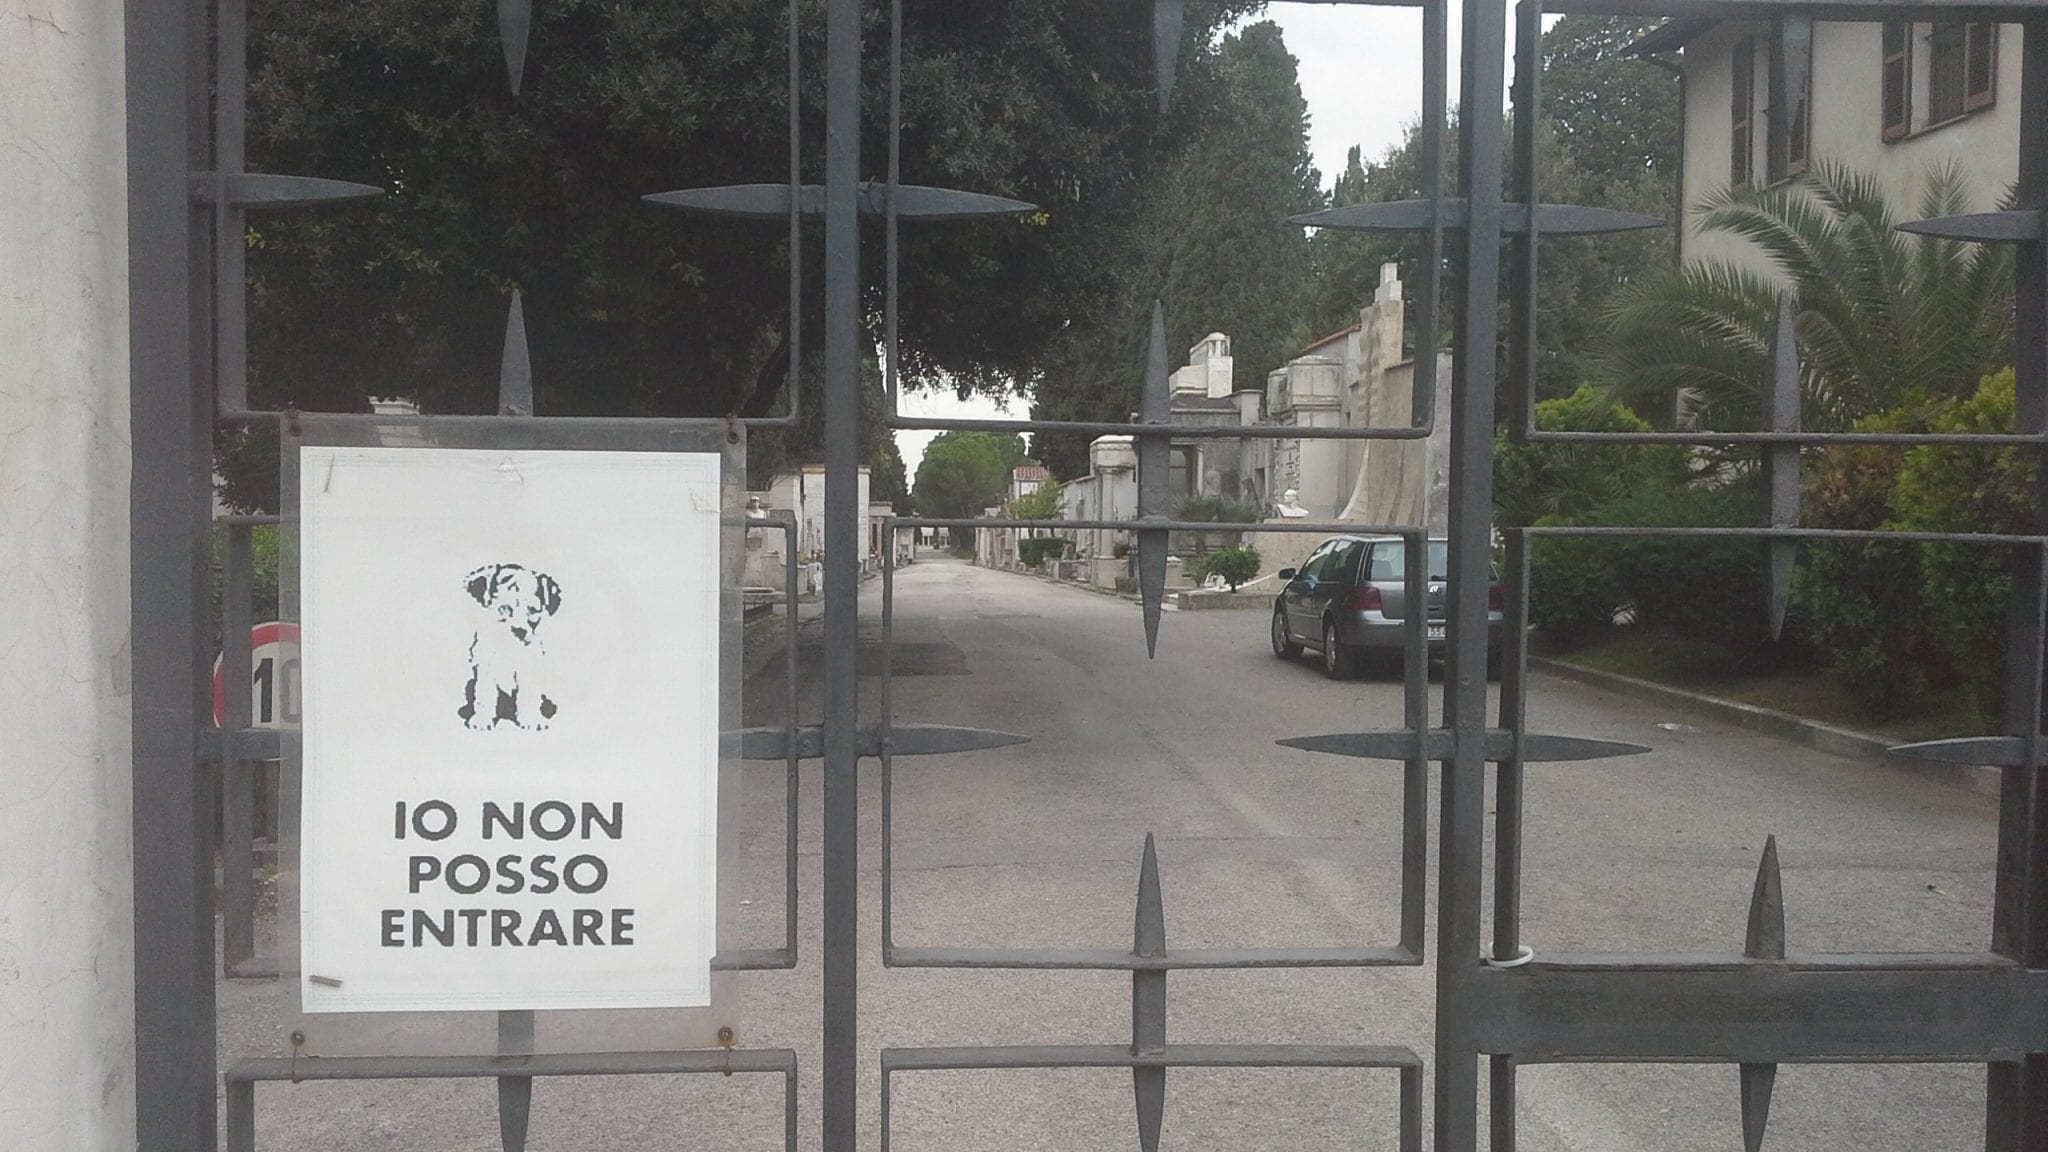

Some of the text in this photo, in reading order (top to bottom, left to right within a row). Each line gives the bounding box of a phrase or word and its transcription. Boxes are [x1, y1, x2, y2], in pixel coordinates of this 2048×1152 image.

[395, 800, 623, 841] IO NON
[409, 854, 608, 895] POSSO
[381, 908, 635, 948] ENTRARE
